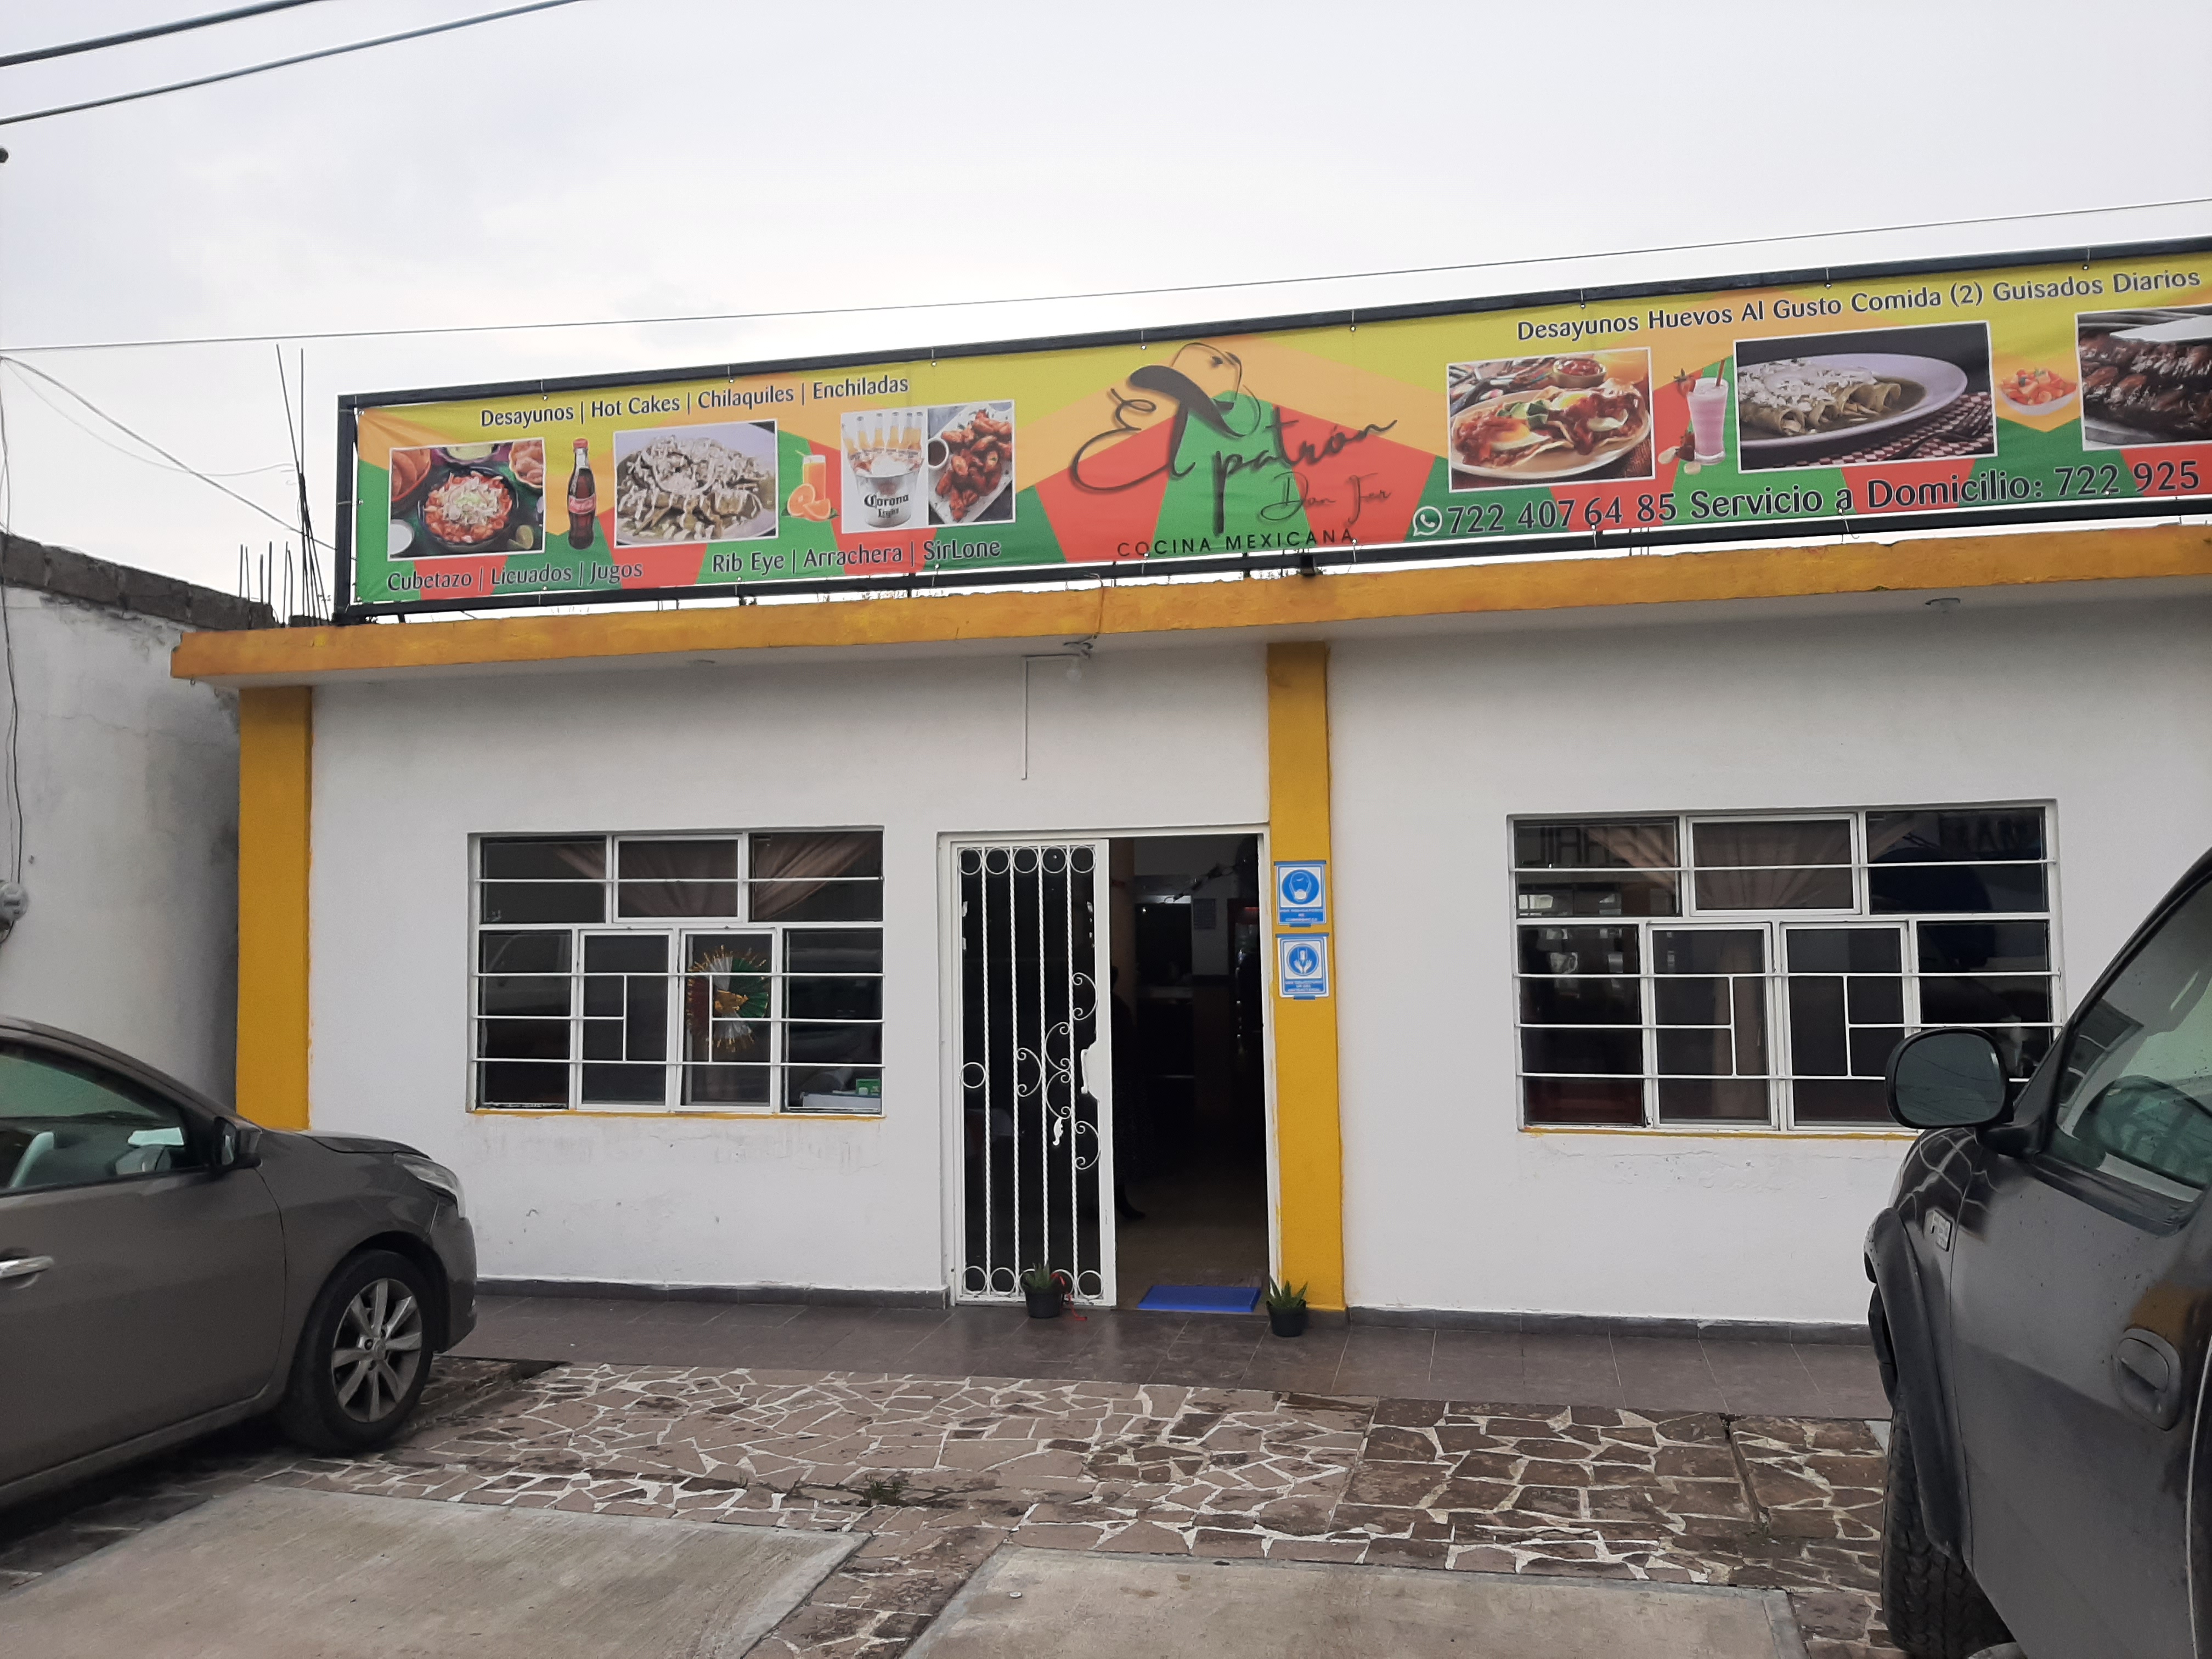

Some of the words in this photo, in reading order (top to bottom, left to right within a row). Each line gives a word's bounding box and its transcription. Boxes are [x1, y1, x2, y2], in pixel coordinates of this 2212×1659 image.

[1517, 315, 1639, 341] Desayunos
[1649, 307, 1733, 329] Huevos
[1742, 300, 1763, 321] Al
[1773, 296, 1841, 319] Gusto
[1852, 286, 1940, 313] Comida
[1950, 281, 1982, 307] (2)
[1993, 276, 2103, 301] Guisados
[2113, 270, 2201, 295] Diarios
[481, 406, 573, 428] Desayunos
[591, 400, 622, 418] Hot
[628, 395, 680, 414] Cakes
[698, 384, 794, 409] Chilaquiles
[813, 375, 909, 399] Enchiladas
[864, 493, 909, 508] Corona
[1448, 505, 1504, 535] 722
[1517, 499, 1576, 528] 407
[1584, 498, 1622, 526] 64
[1637, 493, 1677, 522] 85
[1690, 485, 1822, 518] Servicio
[1836, 488, 1853, 511] a
[1867, 469, 2043, 507] Domicilio:
[2055, 466, 2119, 496] 722
[2135, 461, 2199, 492] 925
[713, 553, 742, 573] Rib
[751, 551, 785, 576] Eye
[803, 544, 902, 568] Arrachera
[923, 540, 1001, 561] SirLone
[1117, 539, 1212, 557] COCINA
[1224, 528, 1354, 550] MEXICANA
[387, 569, 472, 591] Cubetazo
[491, 563, 571, 585] Licuados
[589, 561, 643, 585] Jugos
